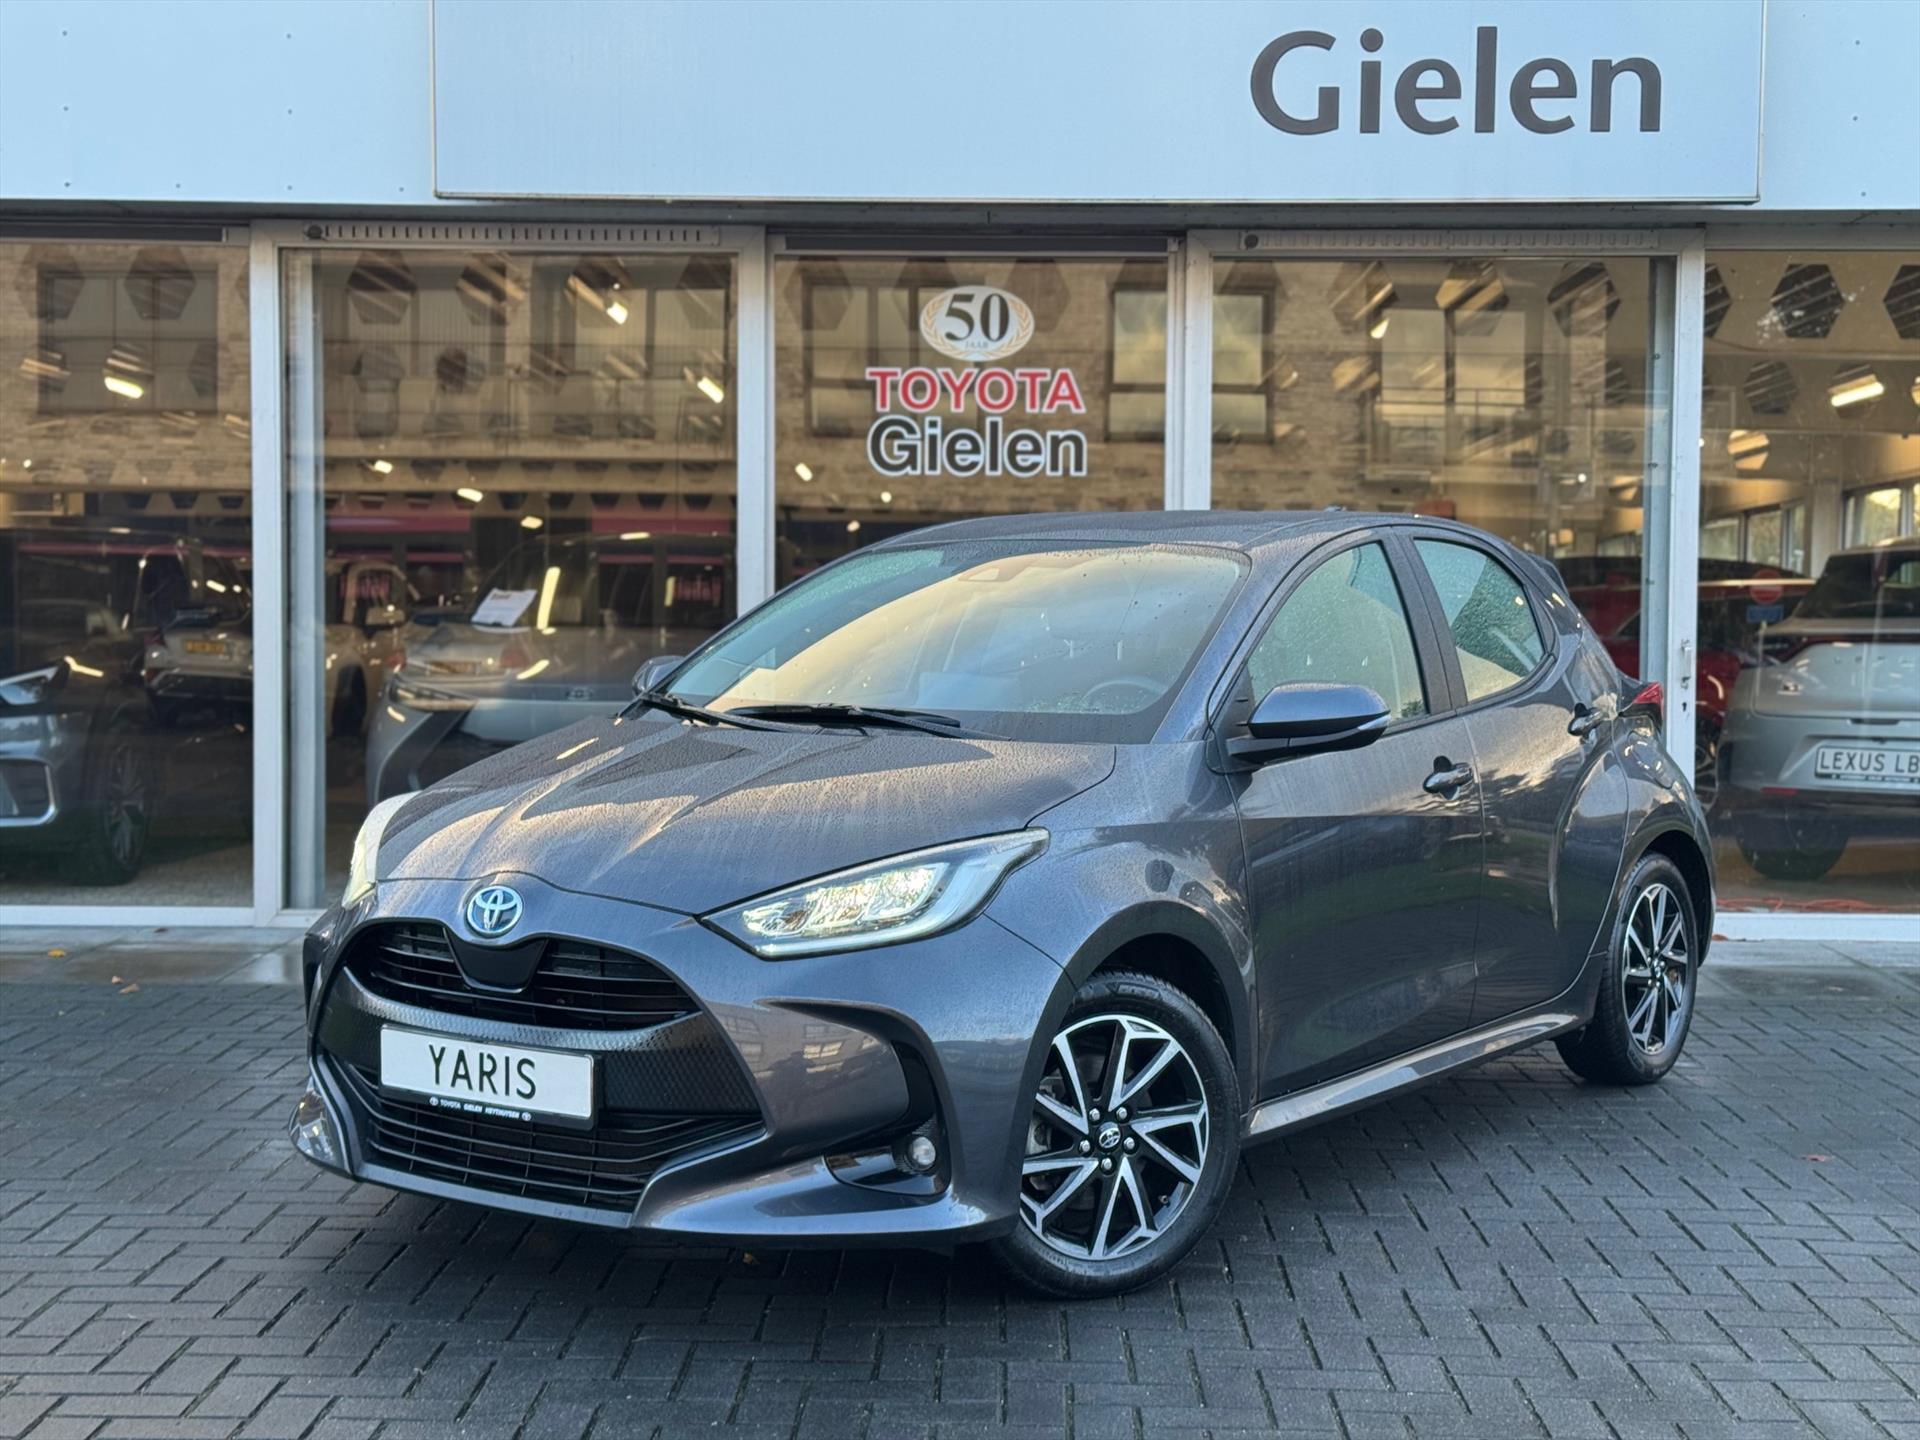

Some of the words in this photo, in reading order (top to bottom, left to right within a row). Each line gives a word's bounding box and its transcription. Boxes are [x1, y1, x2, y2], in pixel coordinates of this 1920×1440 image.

[1249, 26, 1663, 136] Gielen
[945, 293, 1010, 342] 50
[866, 368, 1086, 413] TOYOTA
[868, 415, 1087, 476] Gielen
[1820, 751, 1885, 772] LEXUS
[429, 1044, 536, 1099] YARIS
